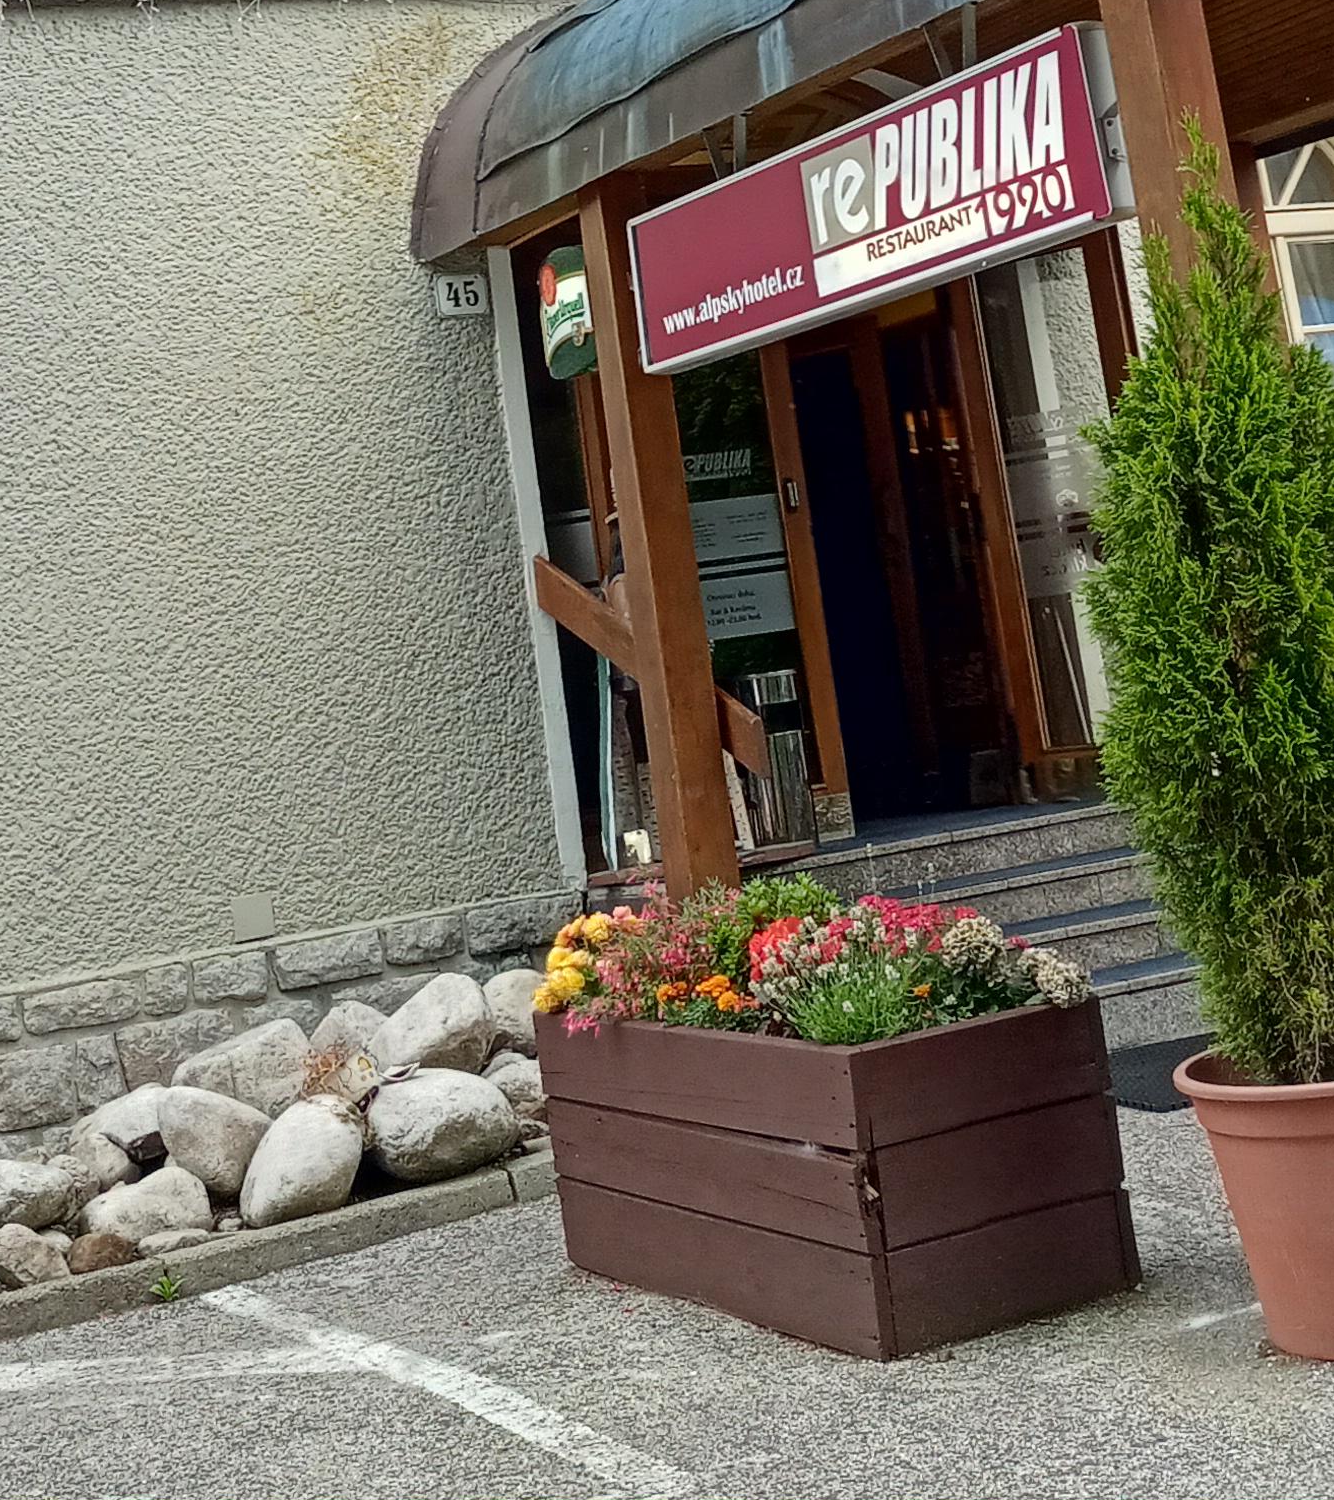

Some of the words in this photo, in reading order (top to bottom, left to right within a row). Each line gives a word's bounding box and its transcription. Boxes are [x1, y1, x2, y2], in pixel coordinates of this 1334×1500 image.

[810, 50, 1066, 246] rePUBLIKA
[866, 205, 973, 262] RESTAURANT
[975, 166, 1068, 240] 1920
[446, 280, 480, 308] 45
[662, 265, 805, 335] www.alpskyhotel.cz
[683, 448, 752, 473] ePUBLIKA
